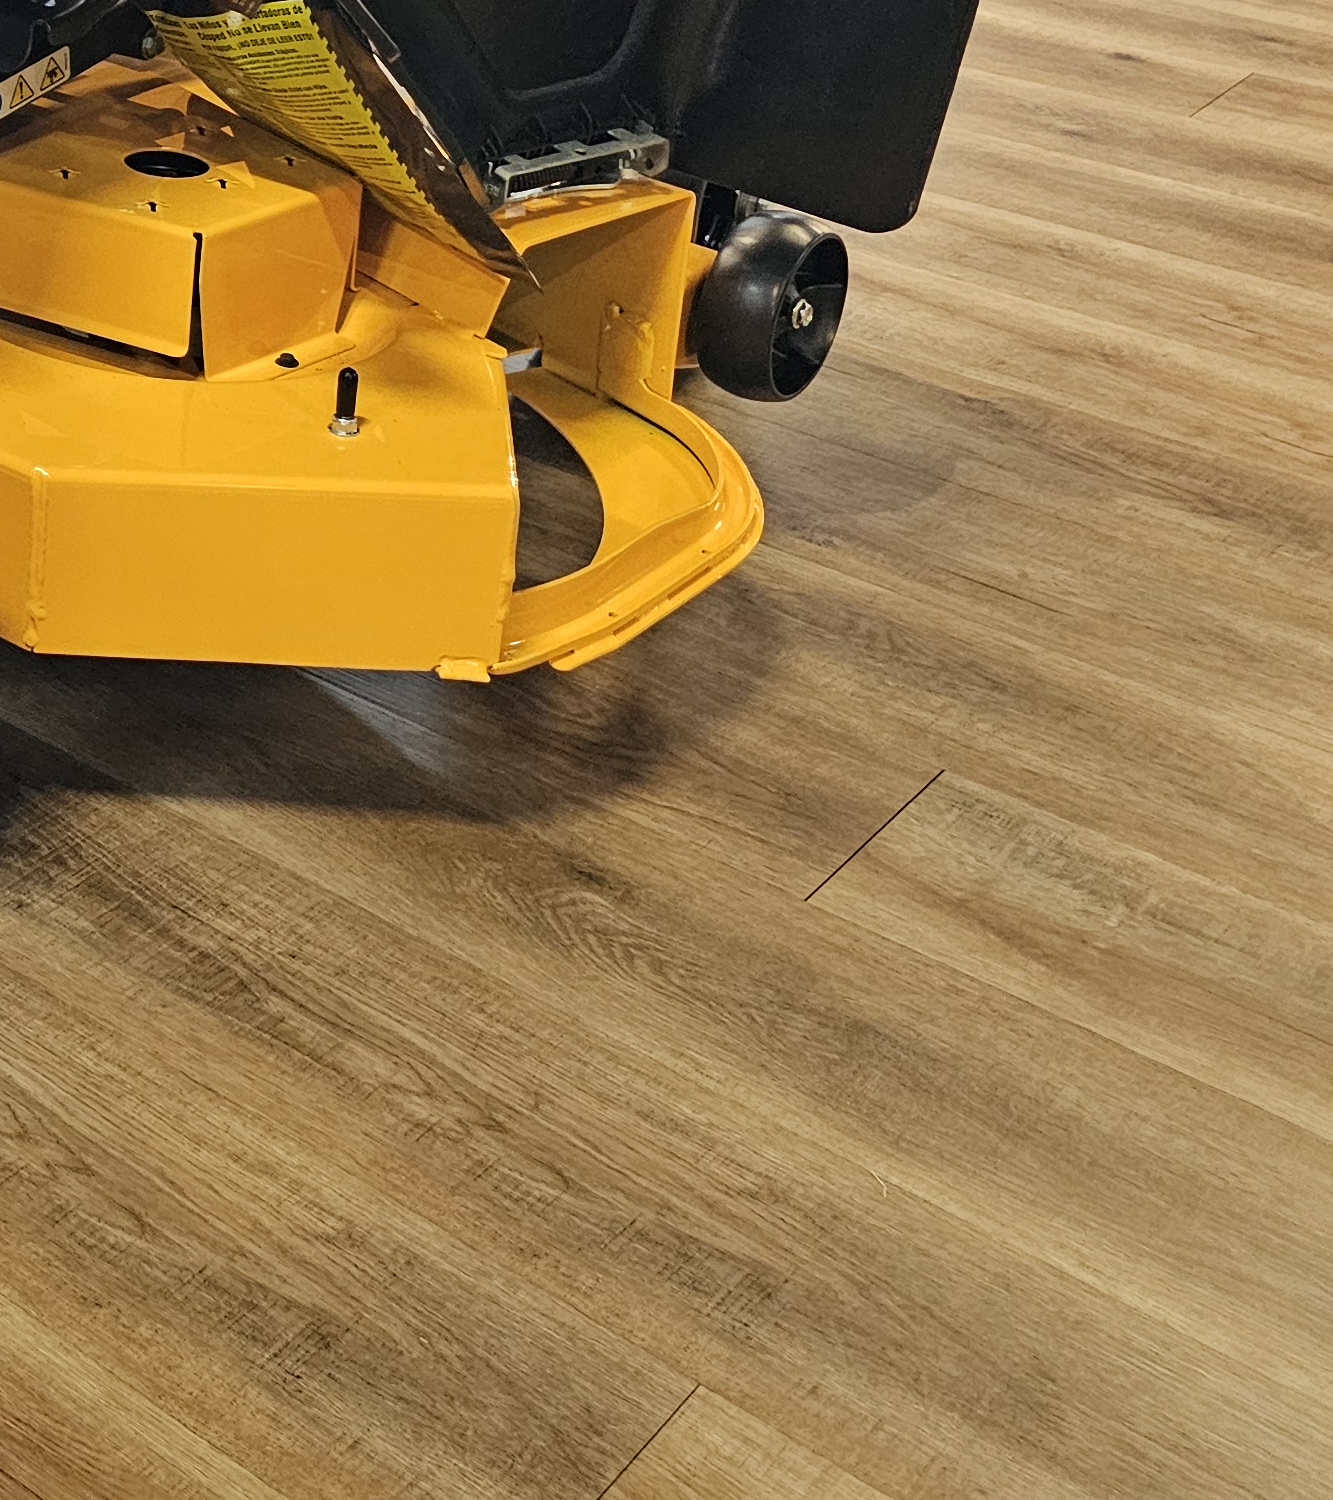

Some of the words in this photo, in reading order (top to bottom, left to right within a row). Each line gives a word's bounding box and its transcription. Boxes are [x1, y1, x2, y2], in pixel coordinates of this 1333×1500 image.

[292, 4, 304, 15] de
[227, 28, 242, 39] No
[243, 26, 254, 34] se
[254, 21, 282, 33] Llevan
[282, 19, 302, 30] Bien
